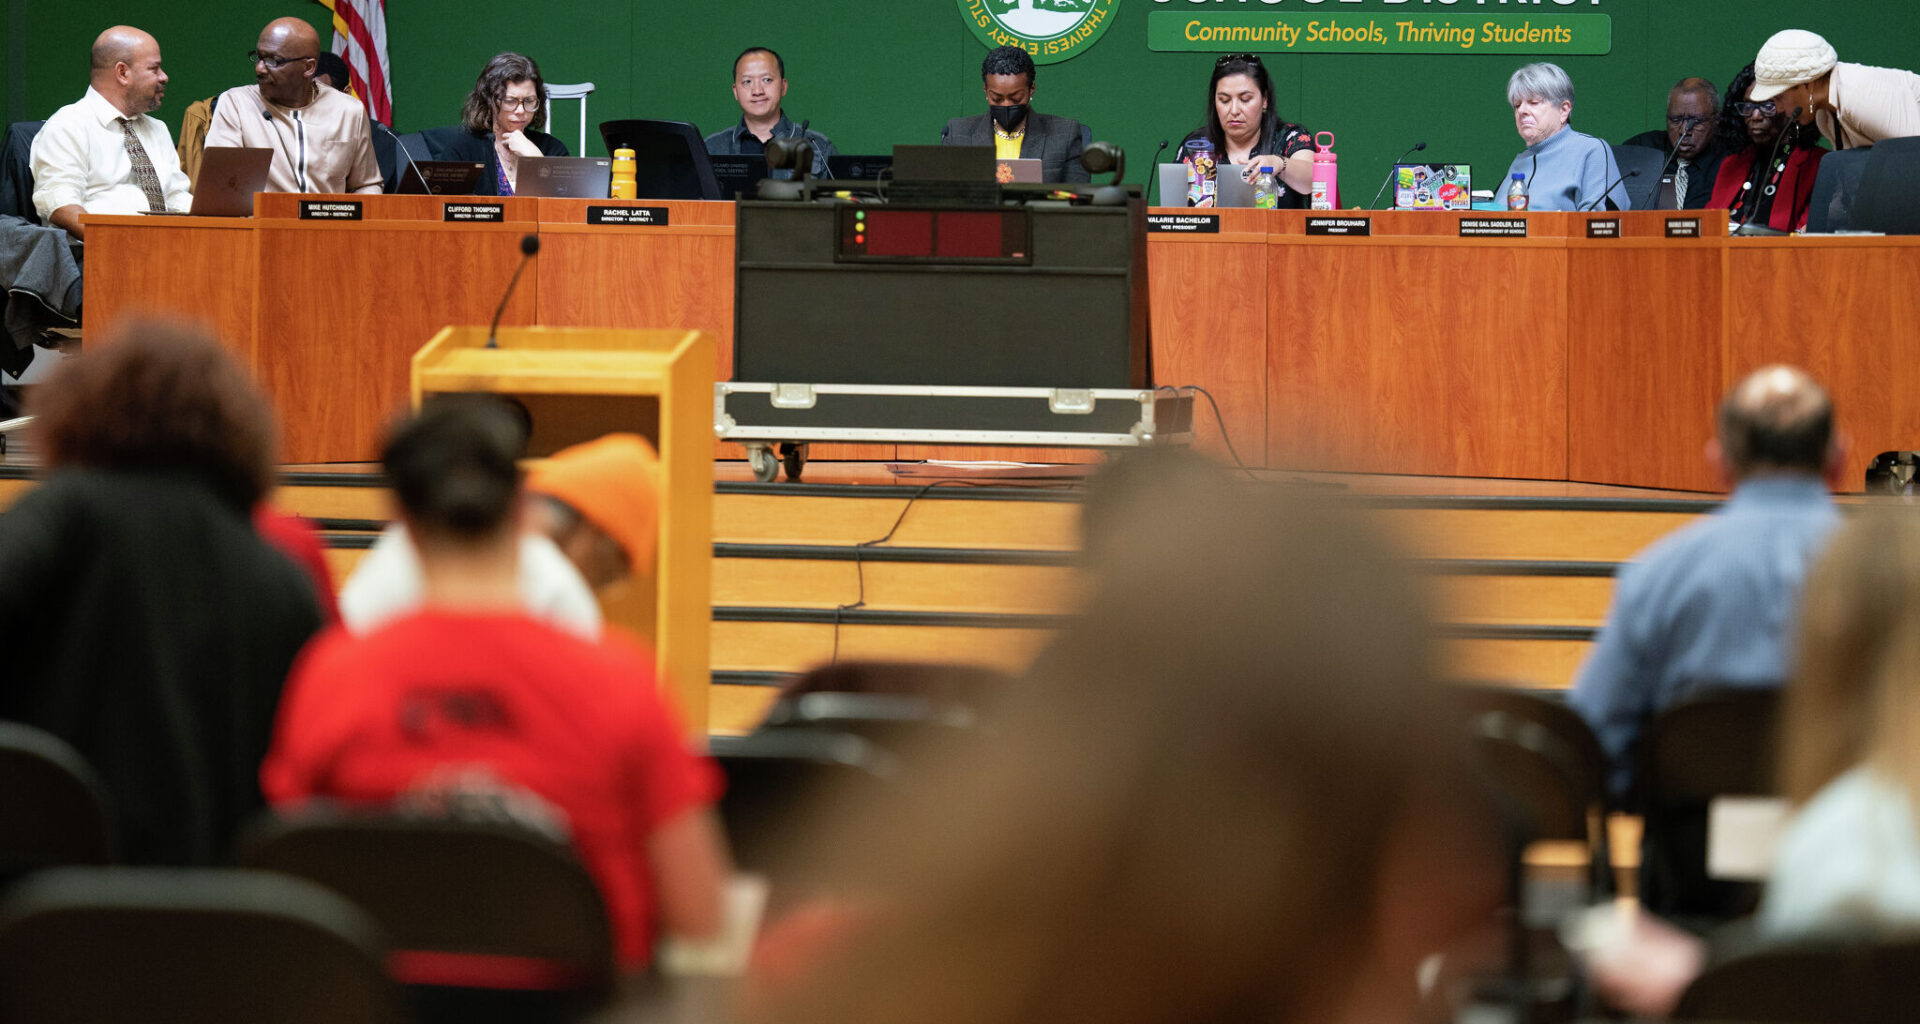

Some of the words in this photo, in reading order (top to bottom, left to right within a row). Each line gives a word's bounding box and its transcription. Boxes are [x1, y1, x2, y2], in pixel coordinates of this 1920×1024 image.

[1044, 8, 1107, 55] THRIVES!
[1185, 20, 1301, 47] Community
[1306, 20, 1388, 45] Schools,
[1396, 21, 1475, 48] Thriving
[1481, 21, 1572, 43] Students
[631, 209, 651, 217] LATTA
[1147, 216, 1175, 224] VALARIE
[1310, 219, 1336, 227] JENNIFER
